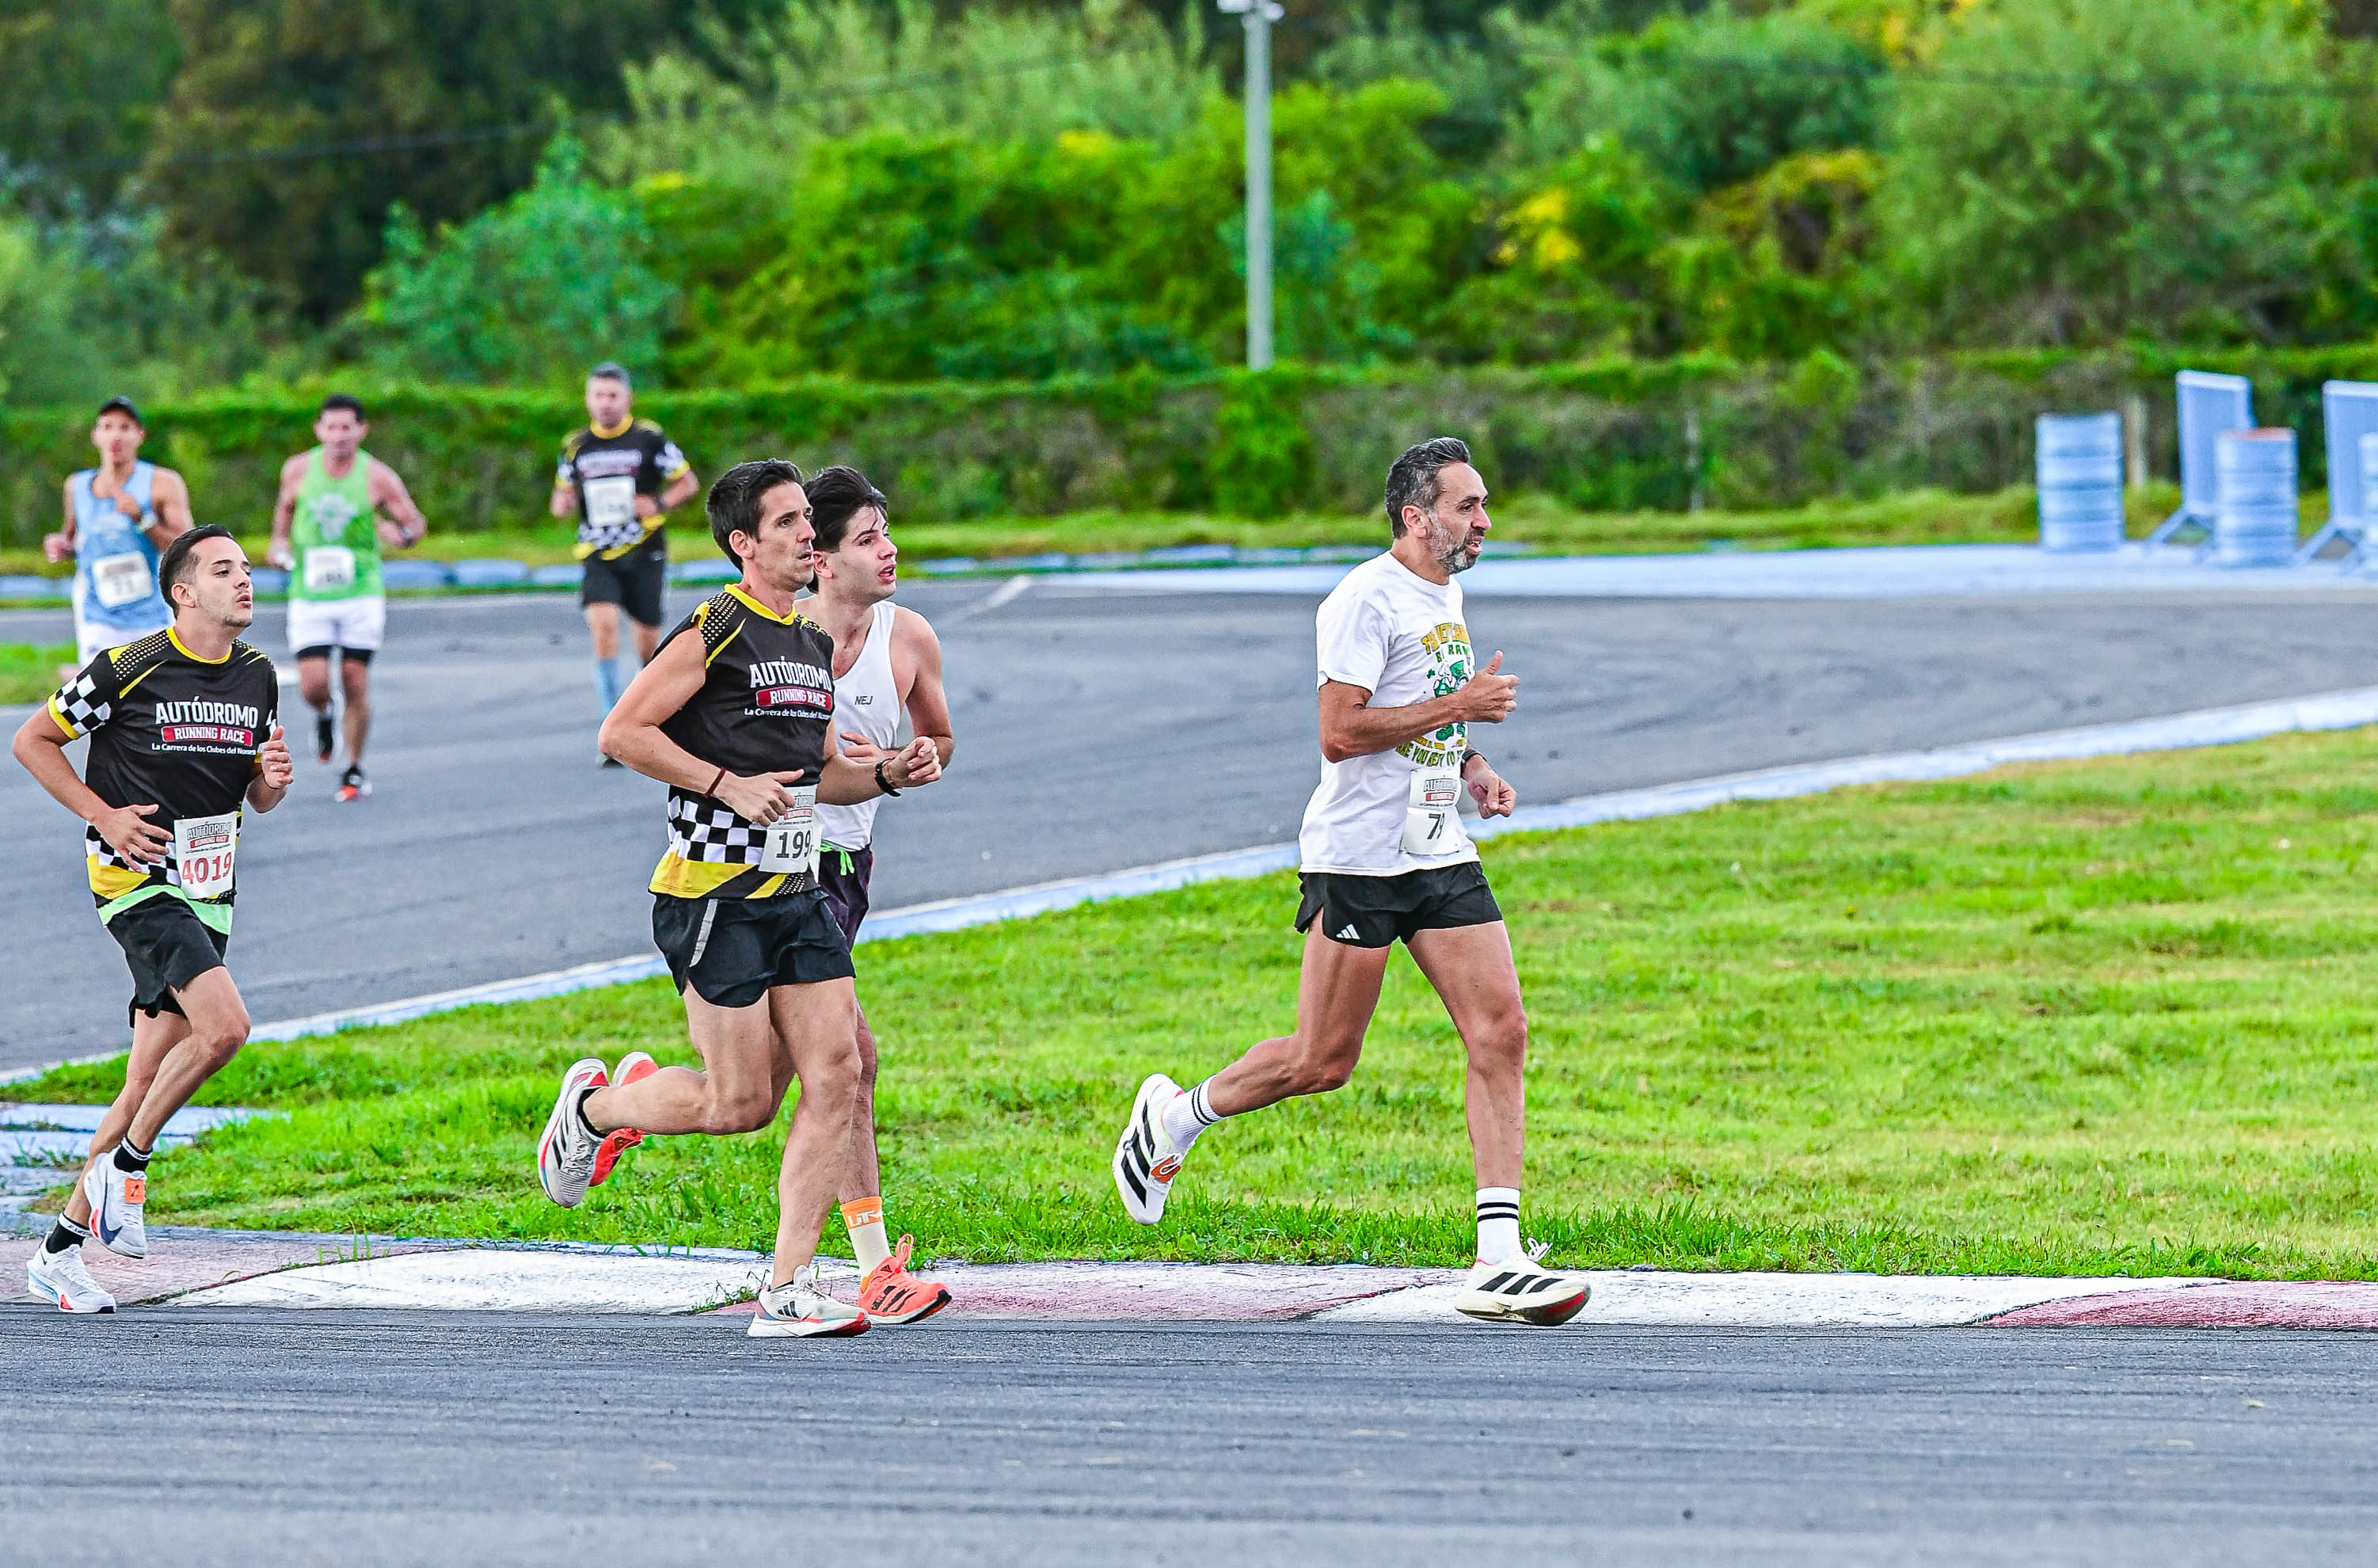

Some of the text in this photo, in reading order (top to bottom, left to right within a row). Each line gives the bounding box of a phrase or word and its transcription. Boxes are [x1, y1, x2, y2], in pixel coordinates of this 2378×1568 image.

[770, 689, 826, 707] RUNNING RACE
[854, 695, 873, 705] NEJ
[155, 695, 258, 729] AUTÓDROMO
[173, 726, 245, 744] RUNNING RACE
[162, 743, 187, 752] Carrera
[226, 746, 236, 755] del
[776, 829, 813, 859] 199
[181, 851, 232, 884] 4019
